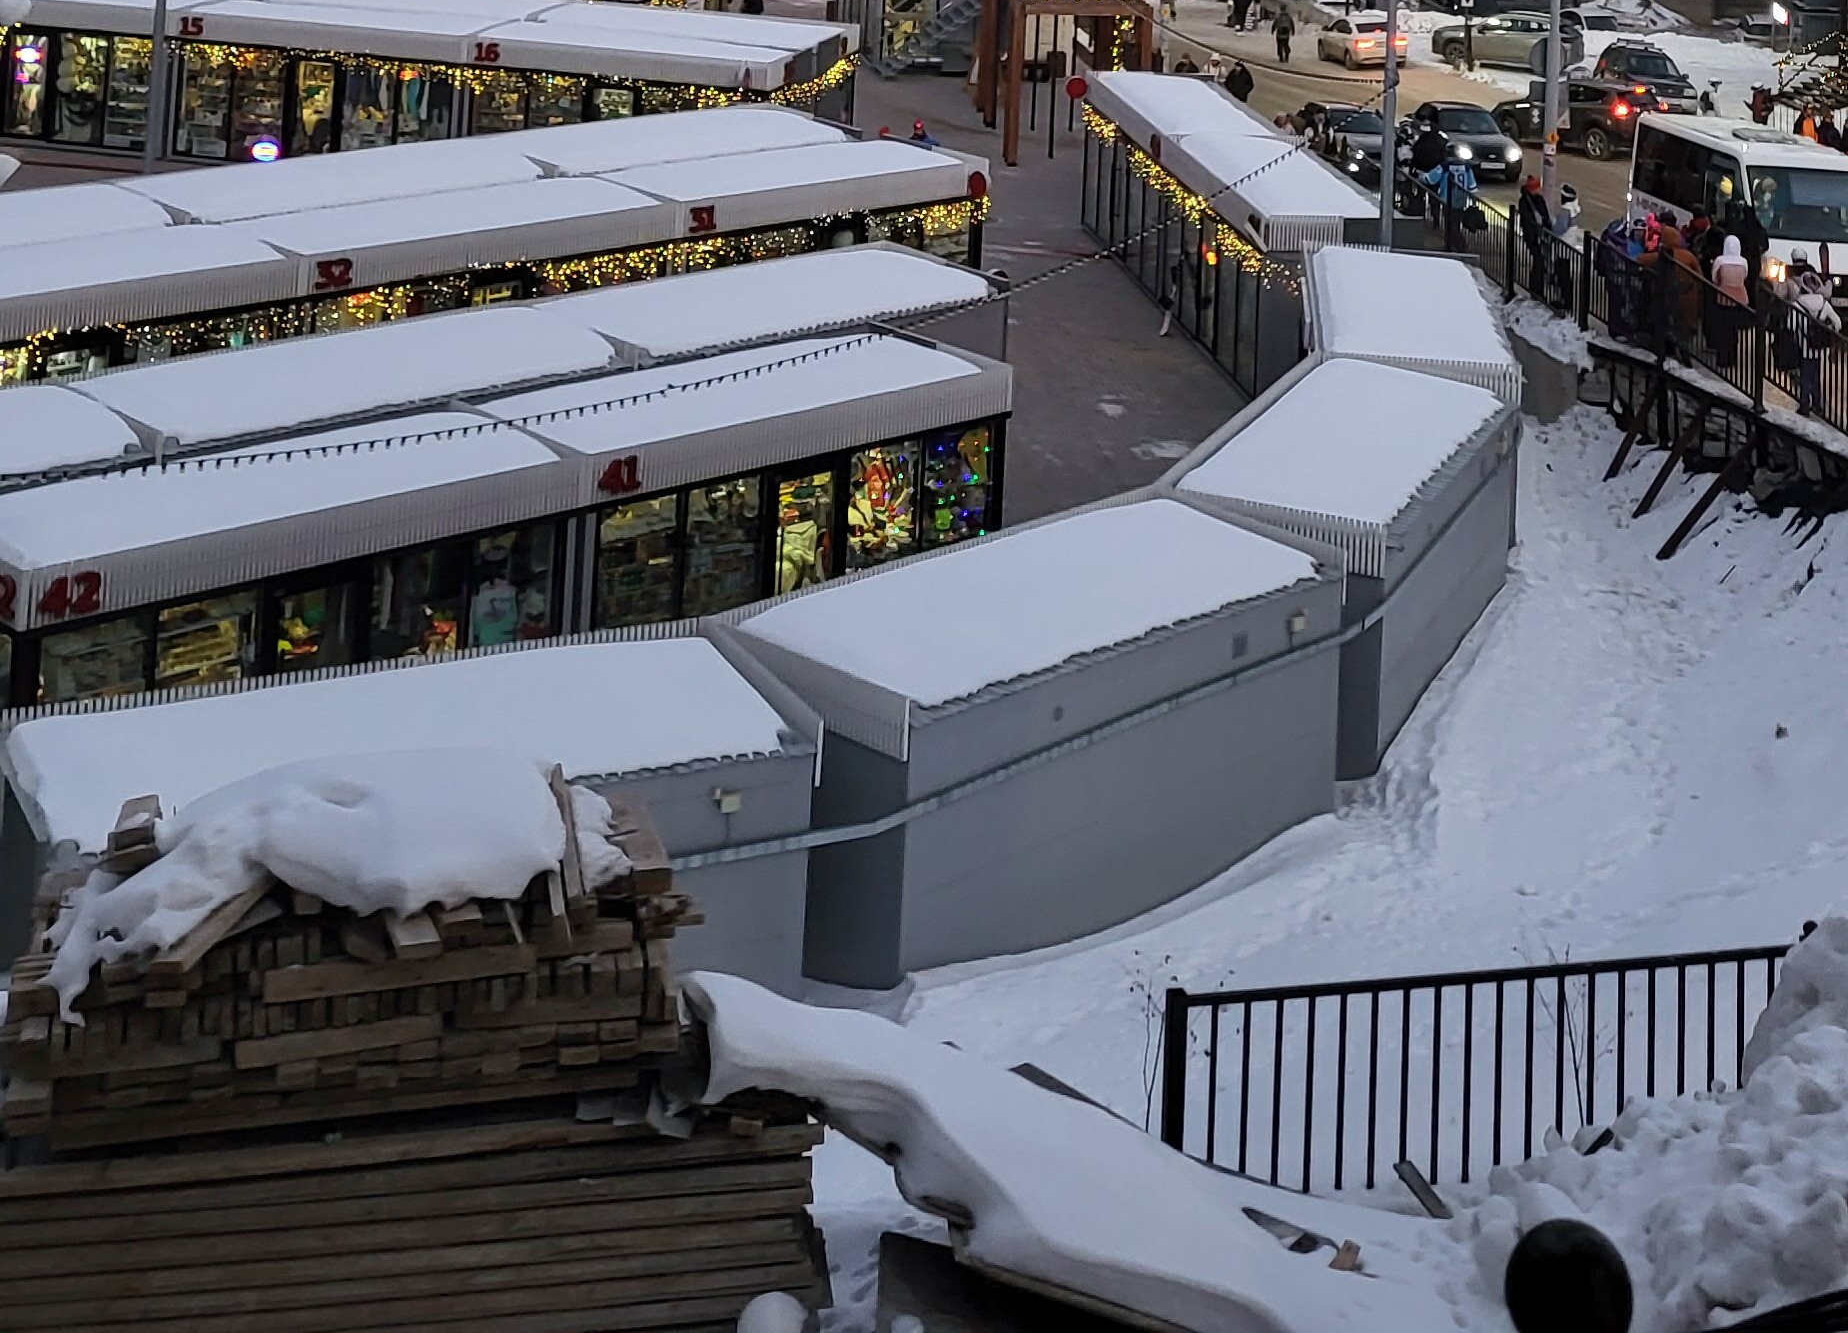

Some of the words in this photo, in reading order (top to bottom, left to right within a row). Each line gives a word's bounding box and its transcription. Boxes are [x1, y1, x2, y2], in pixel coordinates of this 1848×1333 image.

[180, 17, 203, 35] 15
[474, 42, 500, 62] 16
[597, 454, 641, 495] 41
[38, 571, 101, 619] 42
